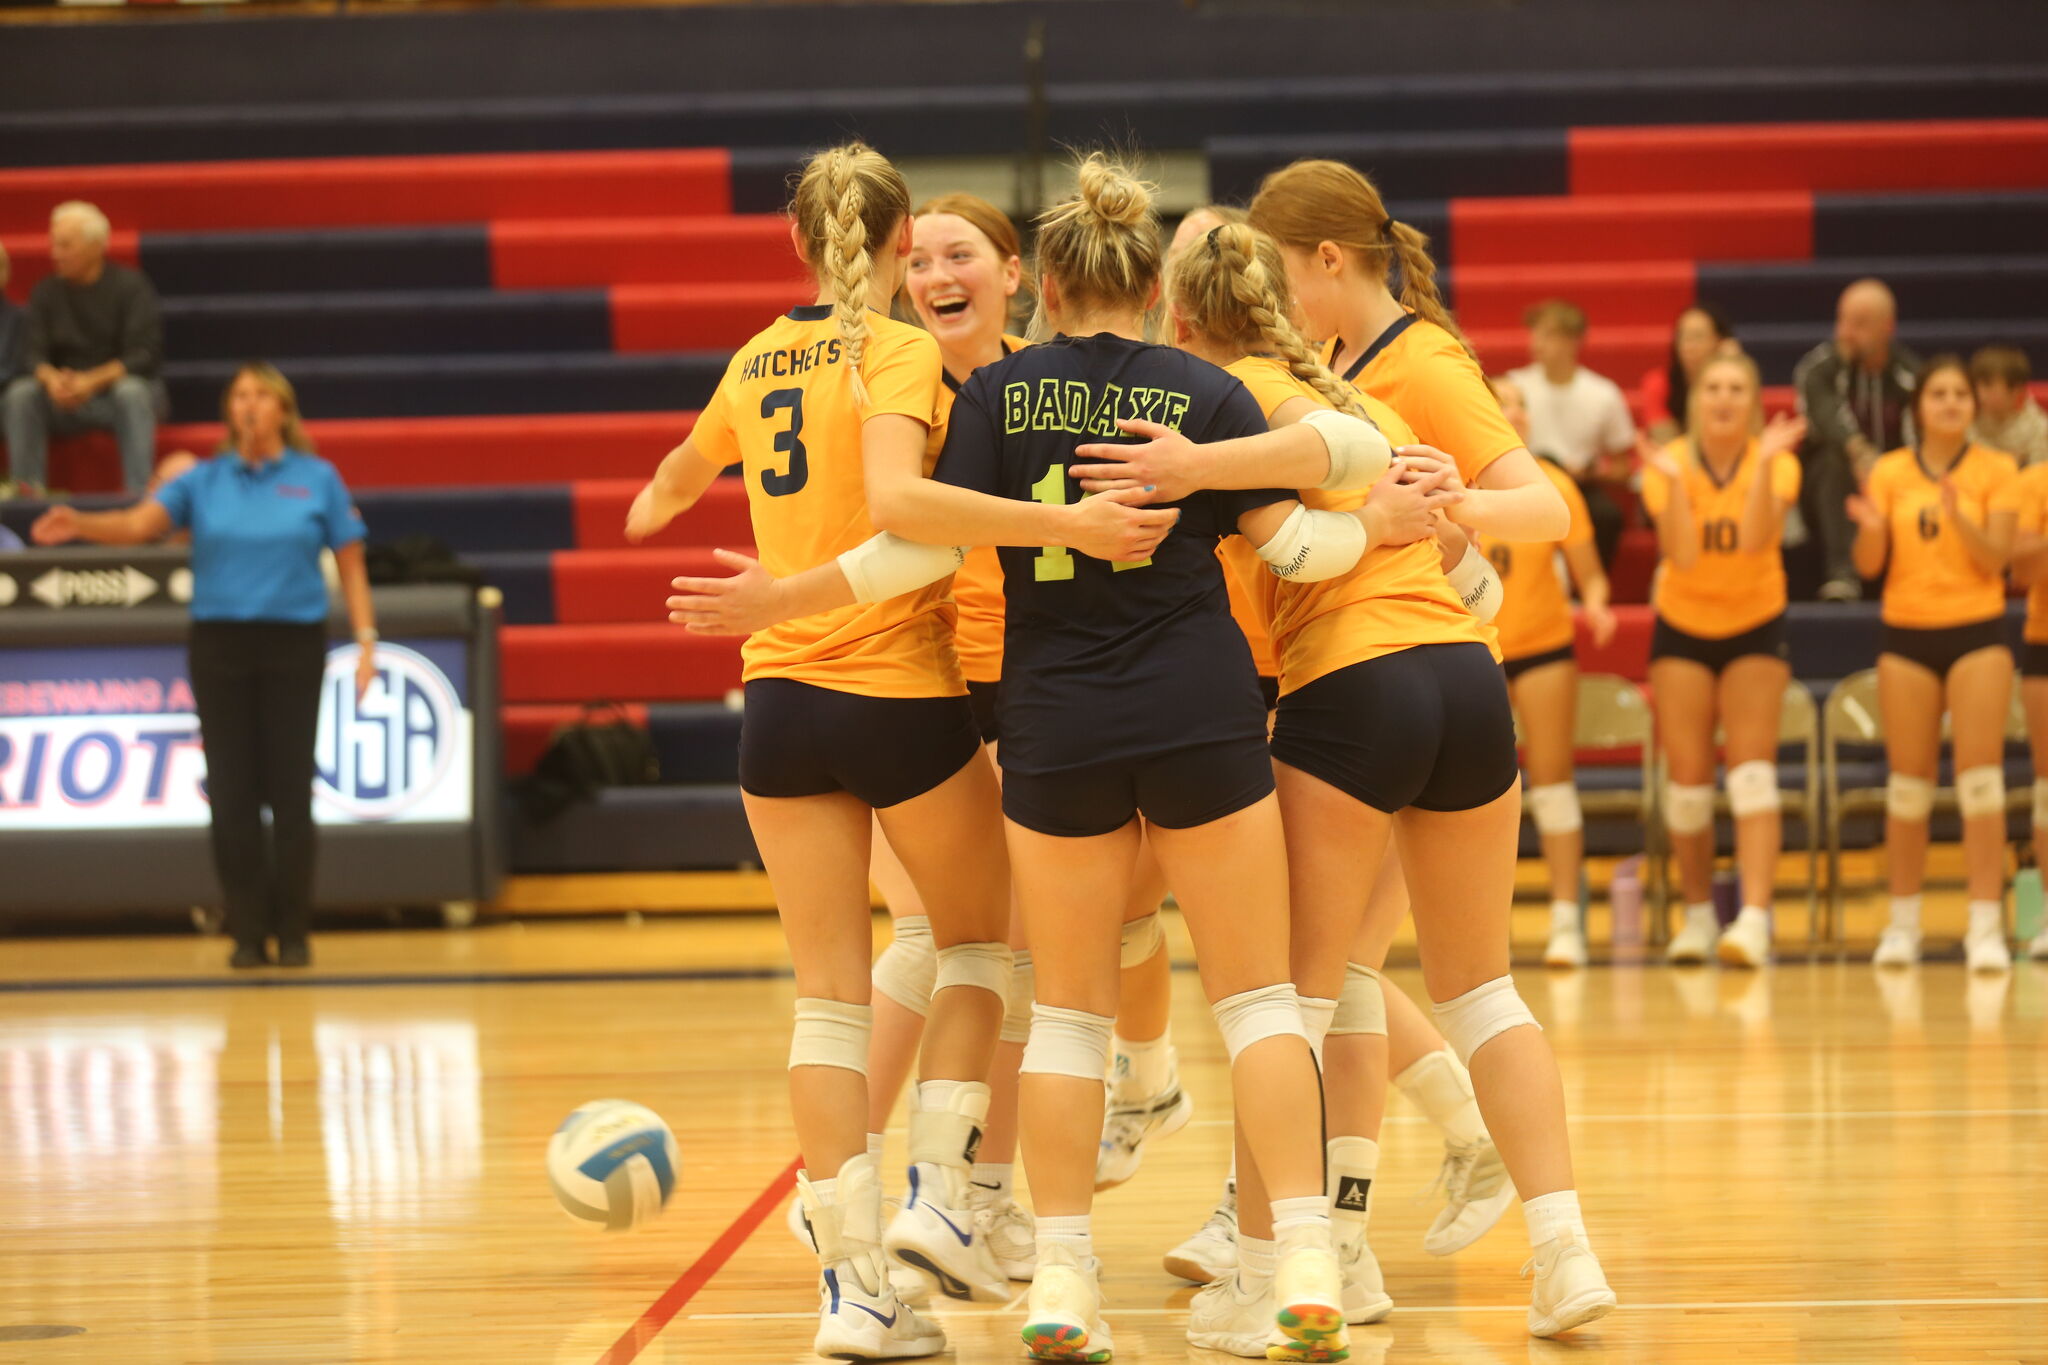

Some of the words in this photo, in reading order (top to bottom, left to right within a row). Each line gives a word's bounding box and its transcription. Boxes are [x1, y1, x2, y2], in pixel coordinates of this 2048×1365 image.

[740, 338, 842, 385] HATCHETS
[760, 387, 808, 497] 3
[1031, 463, 1153, 582] 1
[1703, 518, 1737, 552] 10
[1919, 507, 1938, 540] 6
